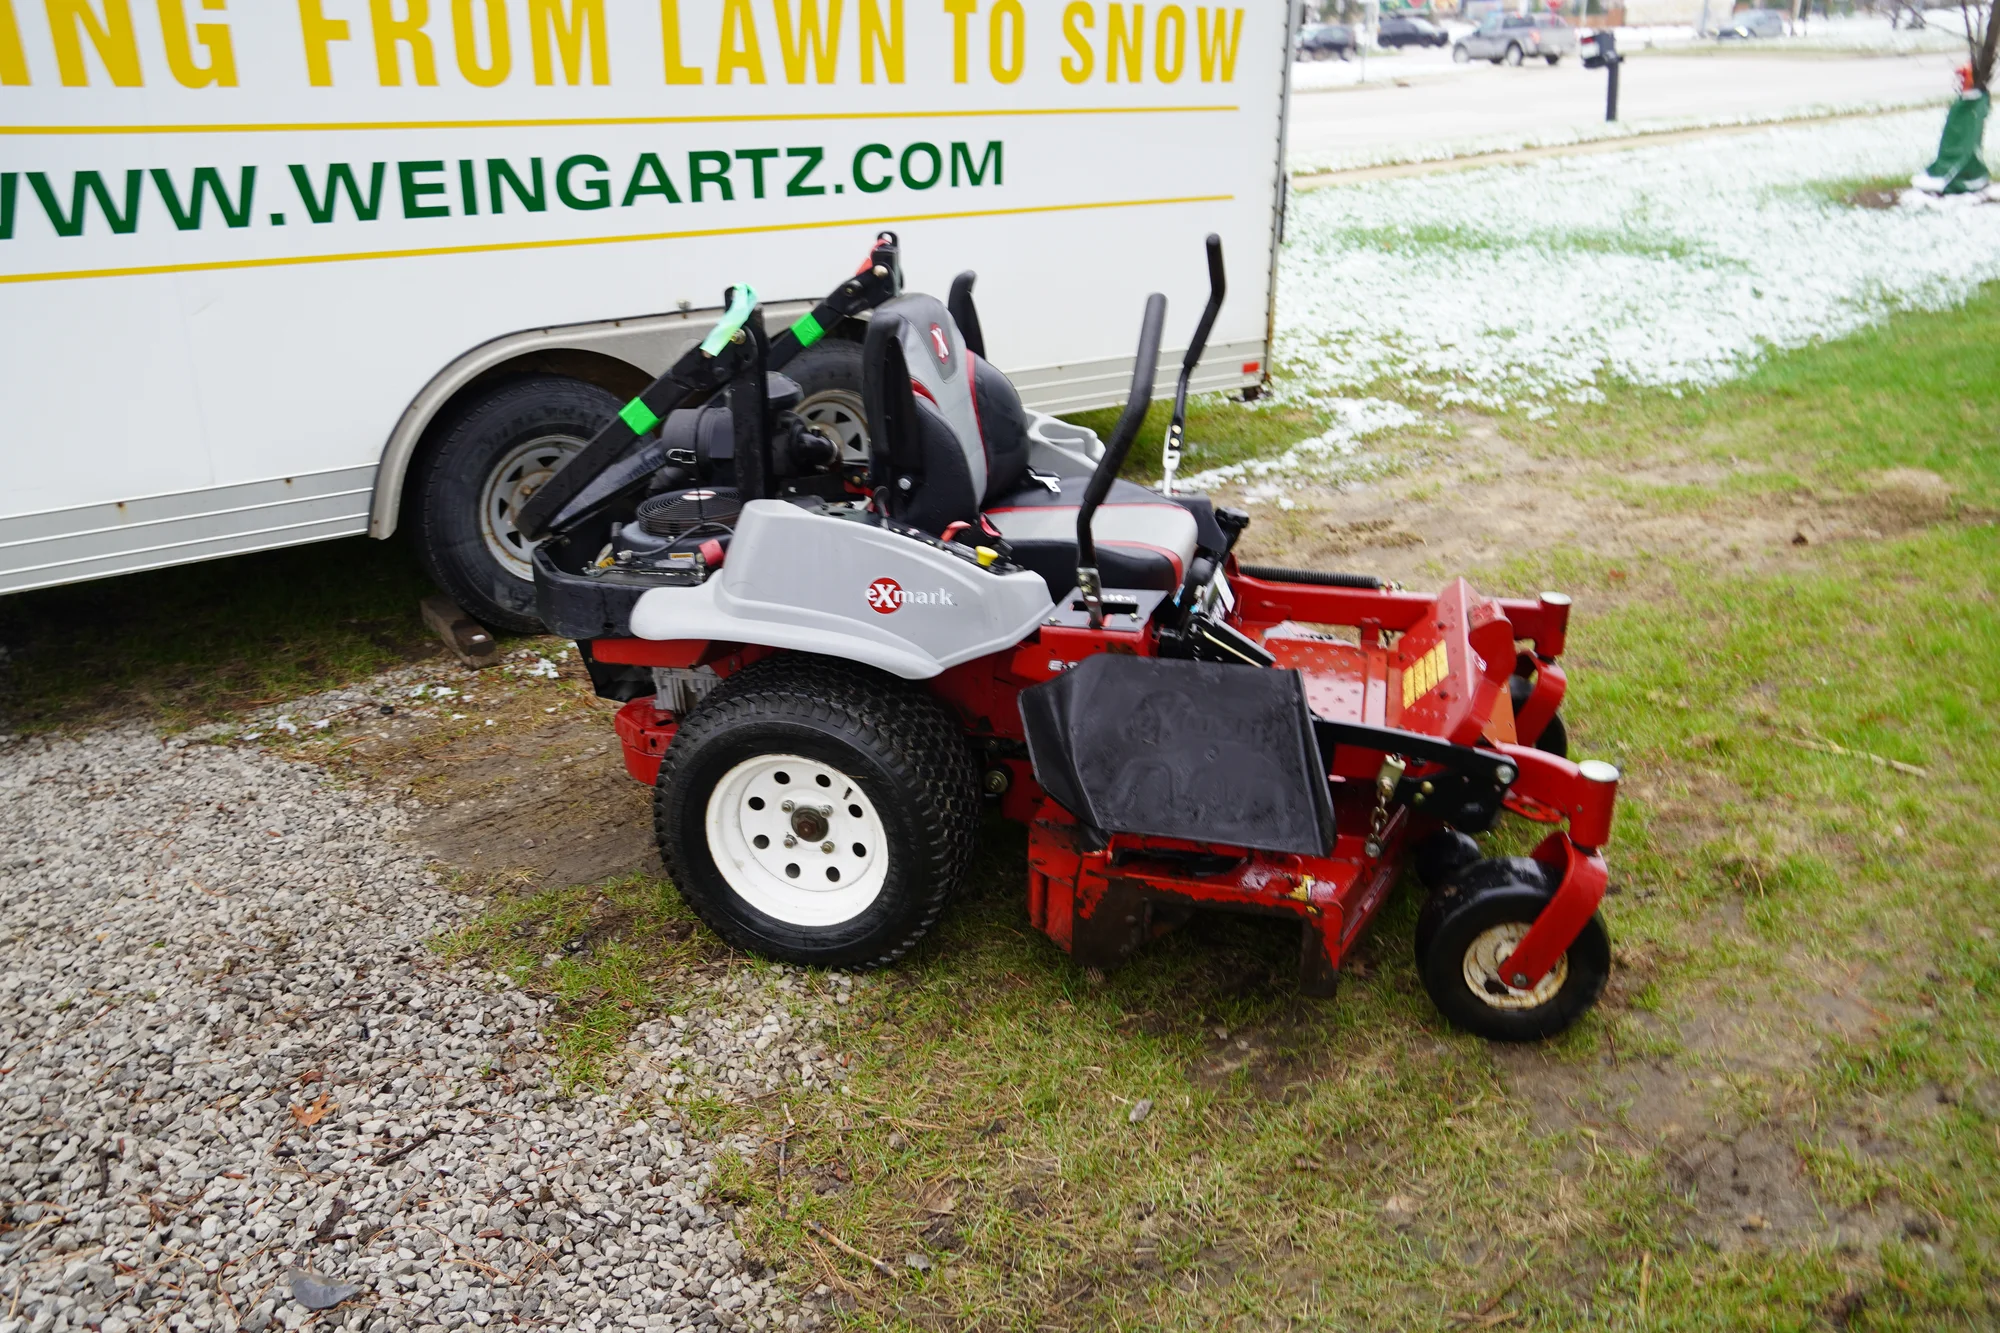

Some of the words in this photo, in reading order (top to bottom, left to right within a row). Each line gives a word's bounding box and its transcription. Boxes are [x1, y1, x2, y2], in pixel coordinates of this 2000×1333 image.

[297, 0, 610, 88] FROM
[660, 0, 905, 85] LAWN
[943, 0, 1025, 84] TO
[1060, 3, 1246, 84] SNOW
[0, 140, 1002, 239] WW.WEINGARTZ.COM
[865, 583, 955, 609] eXmark
